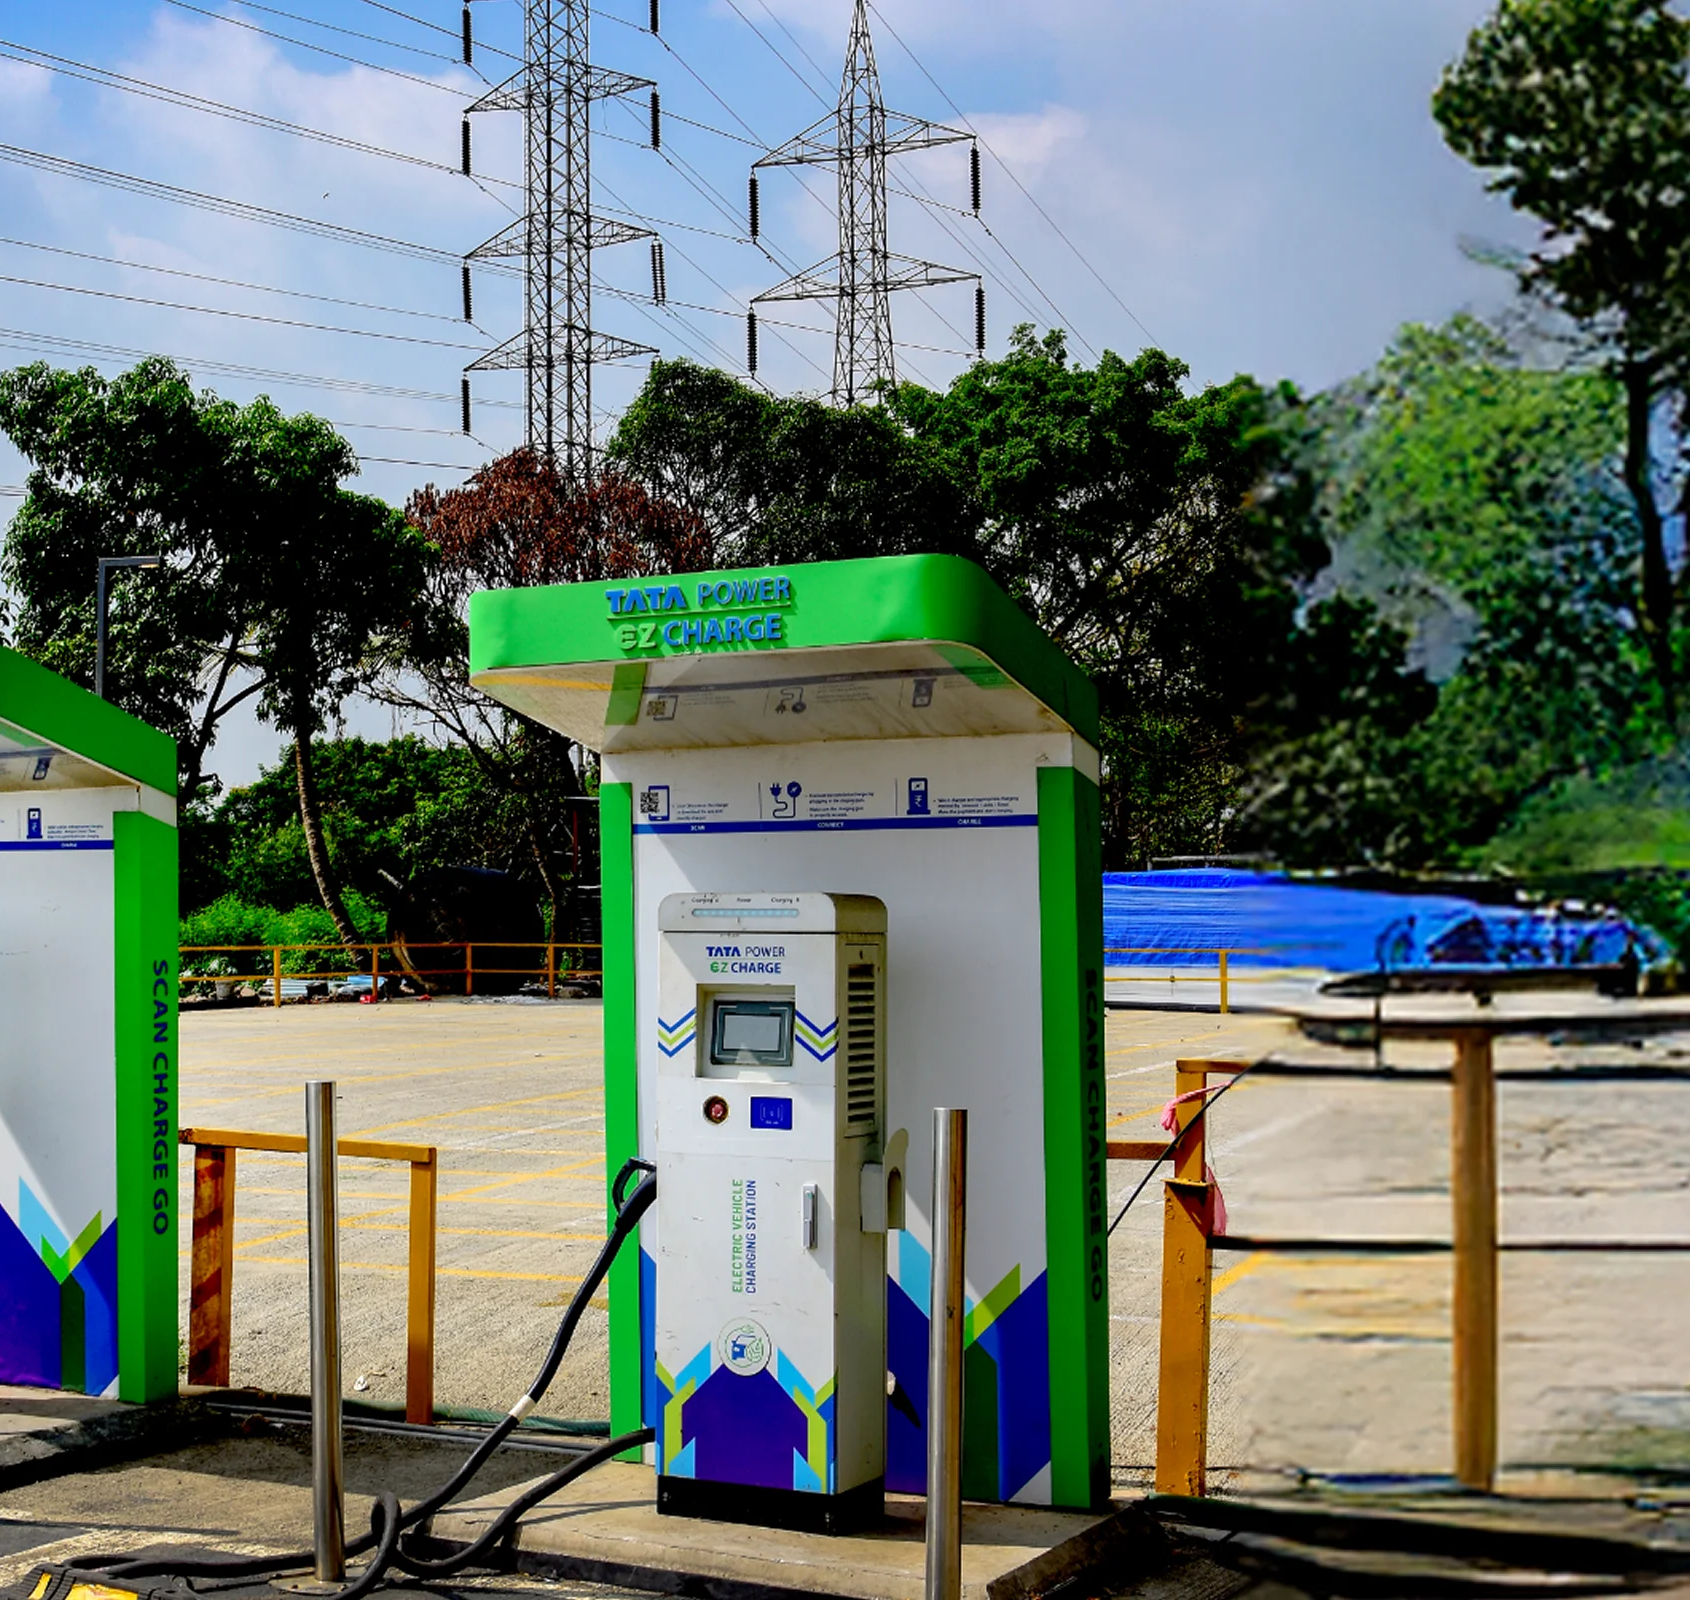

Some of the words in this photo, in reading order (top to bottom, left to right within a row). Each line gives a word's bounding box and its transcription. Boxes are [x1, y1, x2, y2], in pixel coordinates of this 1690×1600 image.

[606, 585, 686, 613] TATA
[698, 576, 791, 605] POWER
[663, 614, 782, 646] CHARGE
[706, 946, 741, 957] TATA
[745, 946, 785, 957] POWER
[731, 962, 781, 973] CHARGE
[153, 960, 168, 1043] SCAN
[1085, 969, 1099, 1070] SCAN
[153, 1052, 168, 1180] CHARGE
[1087, 1080, 1102, 1235] CHARGE
[153, 1188, 168, 1235] GO
[732, 1179, 743, 1230] VEHICLE
[746, 1180, 756, 1230] STATION
[732, 1234, 743, 1293] ELECTRIC
[745, 1233, 756, 1294] CHARGING
[1090, 1245, 1103, 1302] GO
